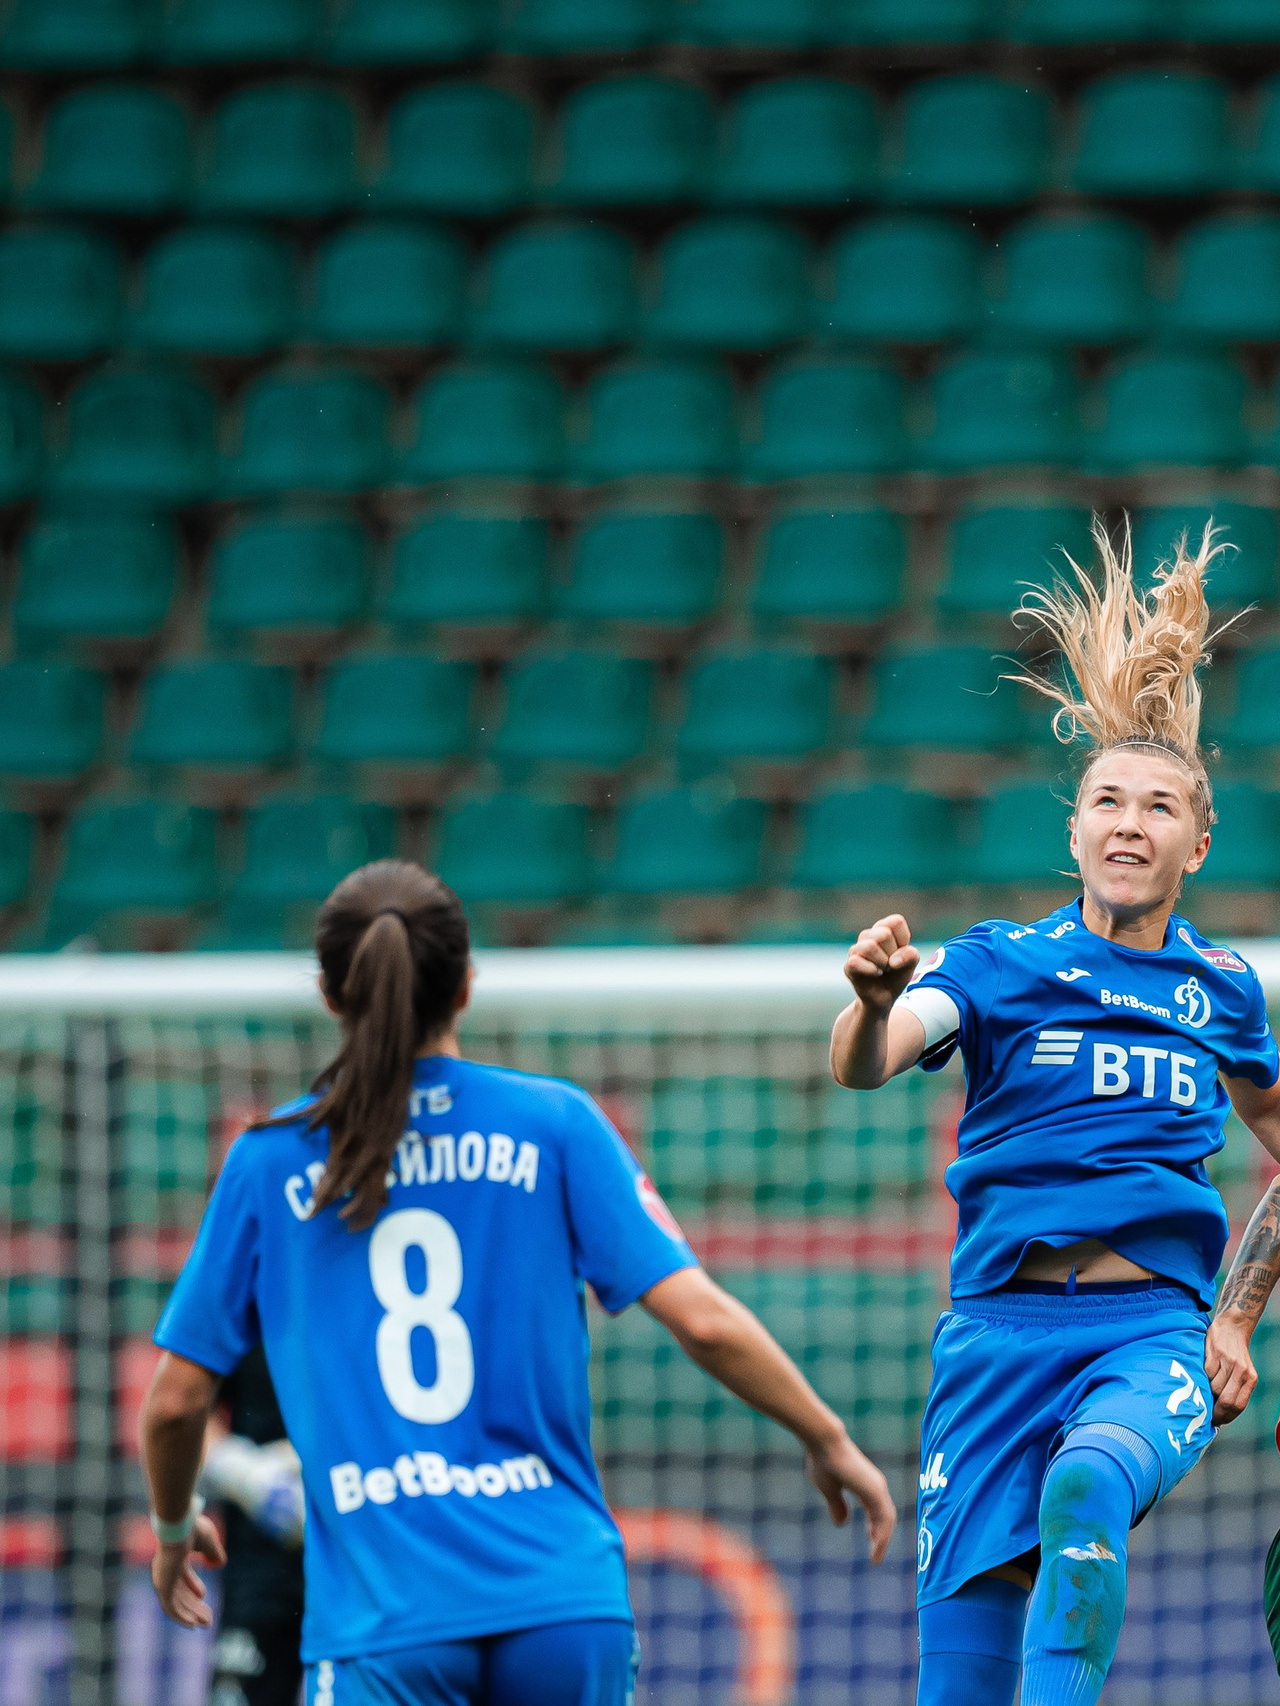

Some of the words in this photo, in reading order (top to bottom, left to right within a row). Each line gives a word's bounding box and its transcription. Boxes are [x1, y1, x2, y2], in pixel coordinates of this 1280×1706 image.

[1100, 988, 1172, 1019] BetBoom
[409, 1083, 454, 1118] ТБ
[1092, 1042, 1197, 1108] ВТБ
[368, 1208, 475, 1425] 8
[330, 1450, 553, 1514] BetBoom
